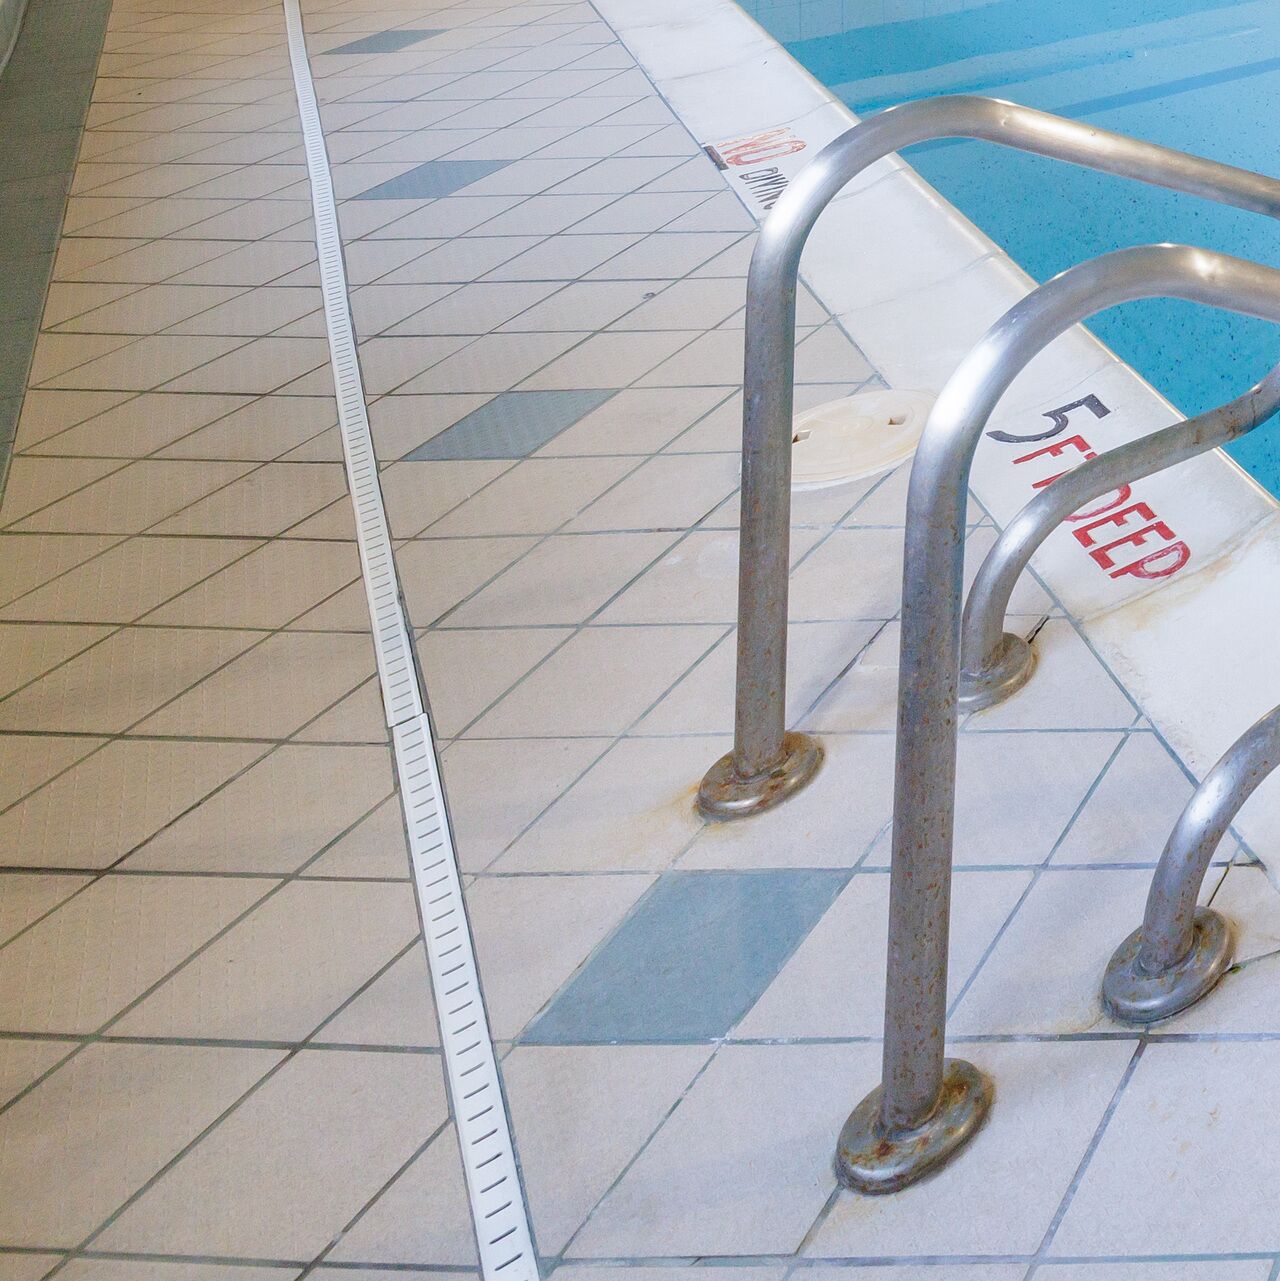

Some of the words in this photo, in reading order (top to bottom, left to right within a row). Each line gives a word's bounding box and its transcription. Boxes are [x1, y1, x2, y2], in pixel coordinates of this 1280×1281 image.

[717, 127, 807, 166] NO
[985, 393, 1111, 444] 5
[1062, 483, 1191, 580] DEEP
